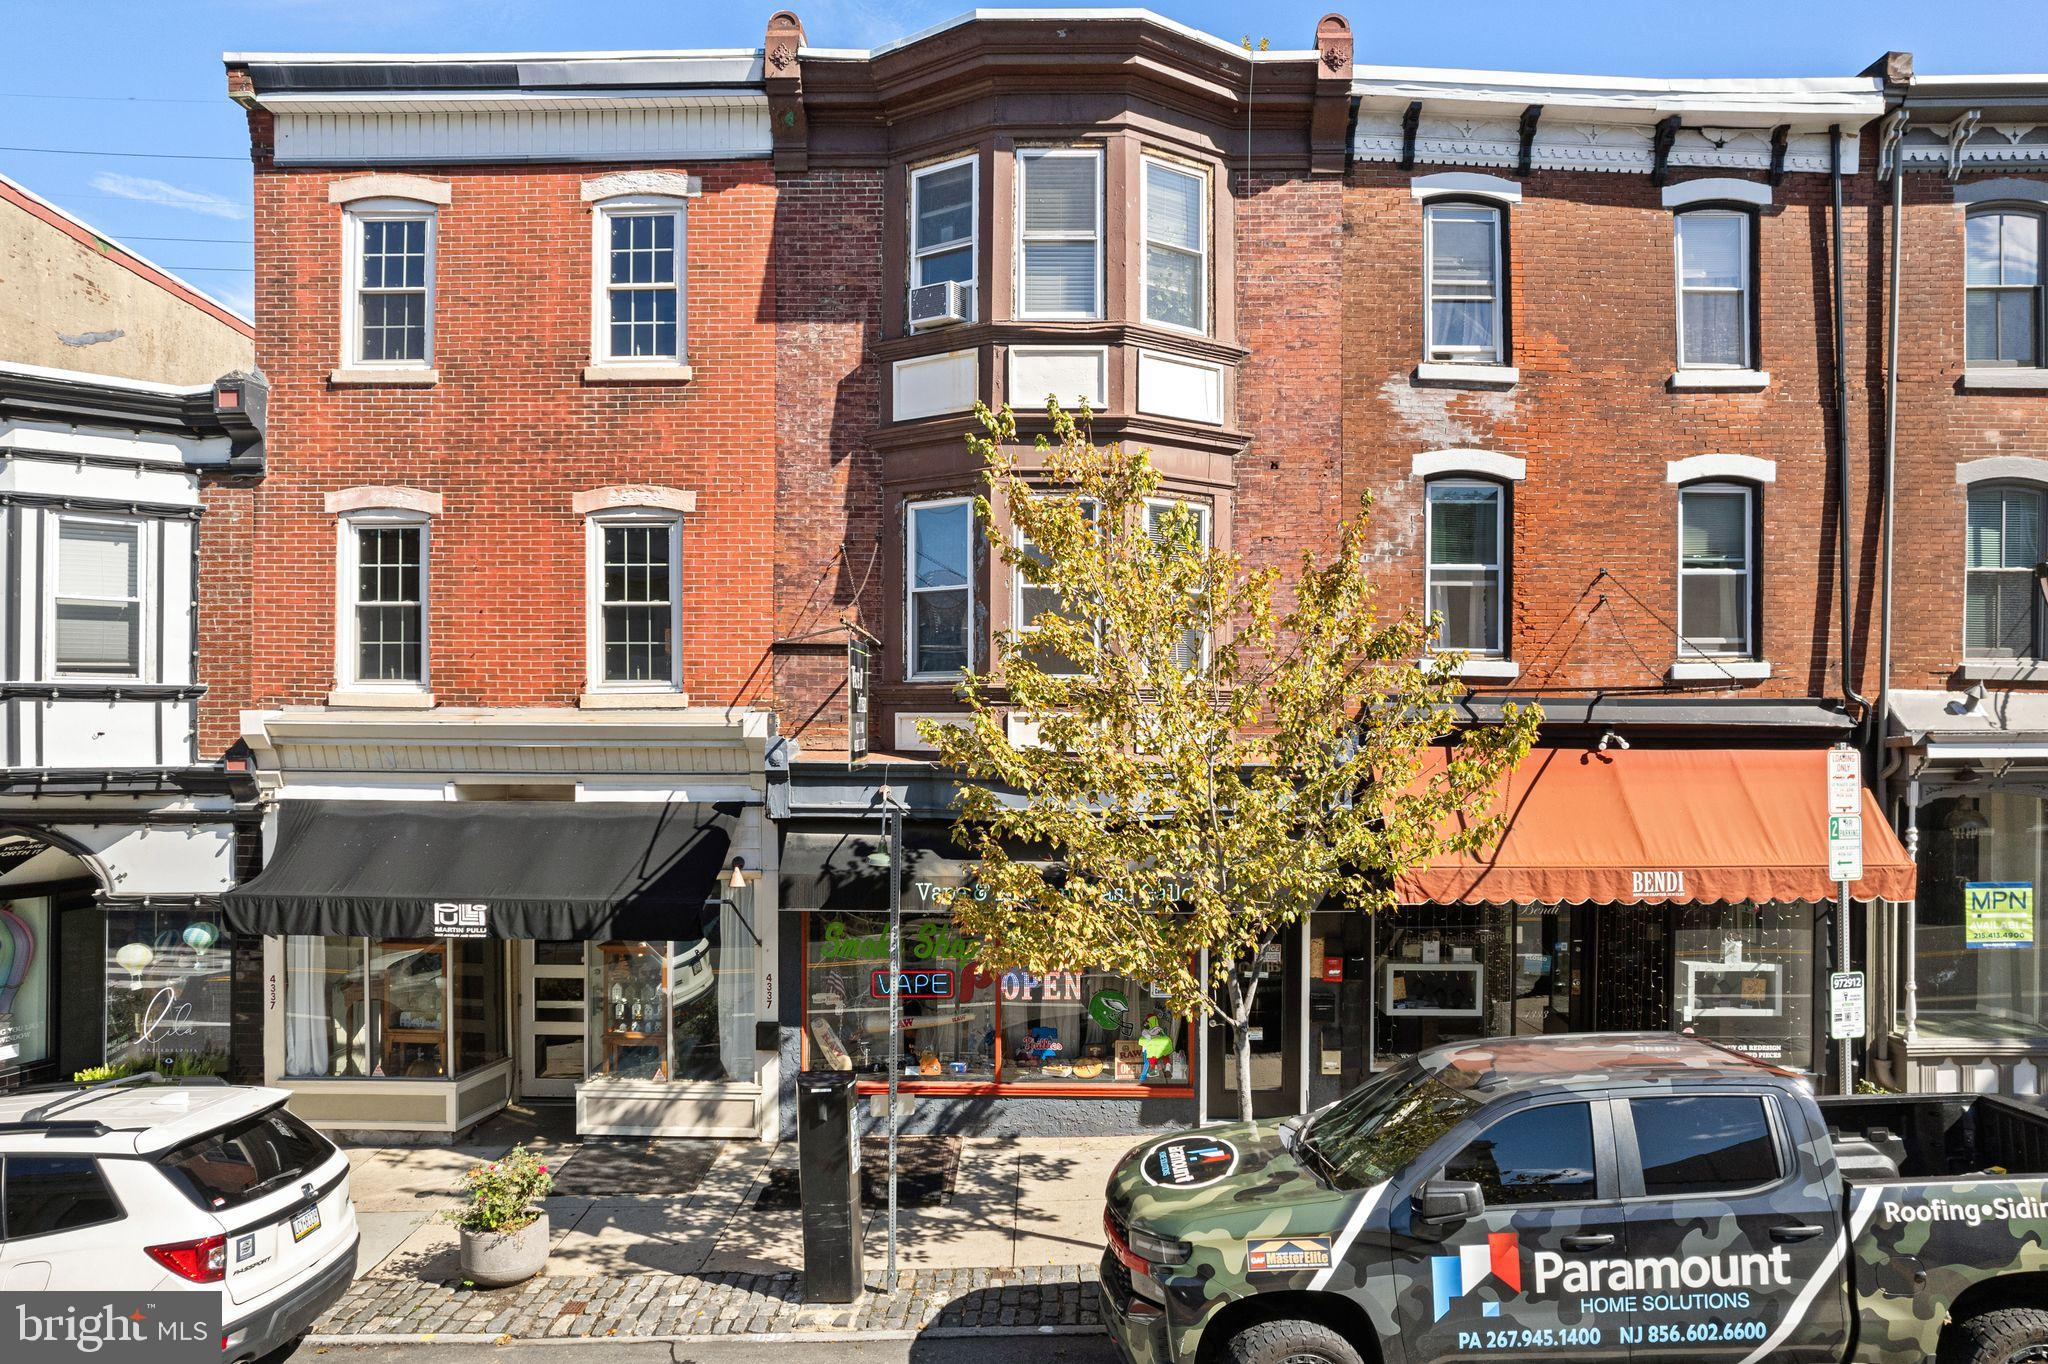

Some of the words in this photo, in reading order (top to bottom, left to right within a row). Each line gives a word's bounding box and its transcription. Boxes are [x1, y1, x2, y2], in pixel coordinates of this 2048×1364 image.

[1836, 763, 1850, 772] ONLY
[1831, 820, 1838, 837] 2
[0, 849, 30, 858] ORTH
[974, 883, 990, 901] &
[1631, 871, 1685, 893] BENDI
[1520, 902, 1560, 915] Bendi
[1971, 891, 2027, 910] MPN
[1970, 921, 2030, 929] AVAILABLE
[820, 921, 893, 959] Smok
[878, 973, 948, 994] VAPE
[1001, 971, 1083, 1001] OPEN
[1834, 977, 1862, 989] 972912
[1120, 1049, 1143, 1059] RAW
[1993, 1196, 2048, 1220] Sidin
[233, 1255, 272, 1276] PASSPORT
[1534, 1245, 1792, 1294] Paramount
[1580, 1296, 1638, 1314] HOME
[1642, 1293, 1751, 1312] SOLUTIONS
[1459, 1331, 1482, 1350] PA
[1486, 1326, 1601, 1350] 267.945.1400
[1619, 1326, 1643, 1345] NJ
[1648, 1321, 1768, 1344] 856.602.6600
